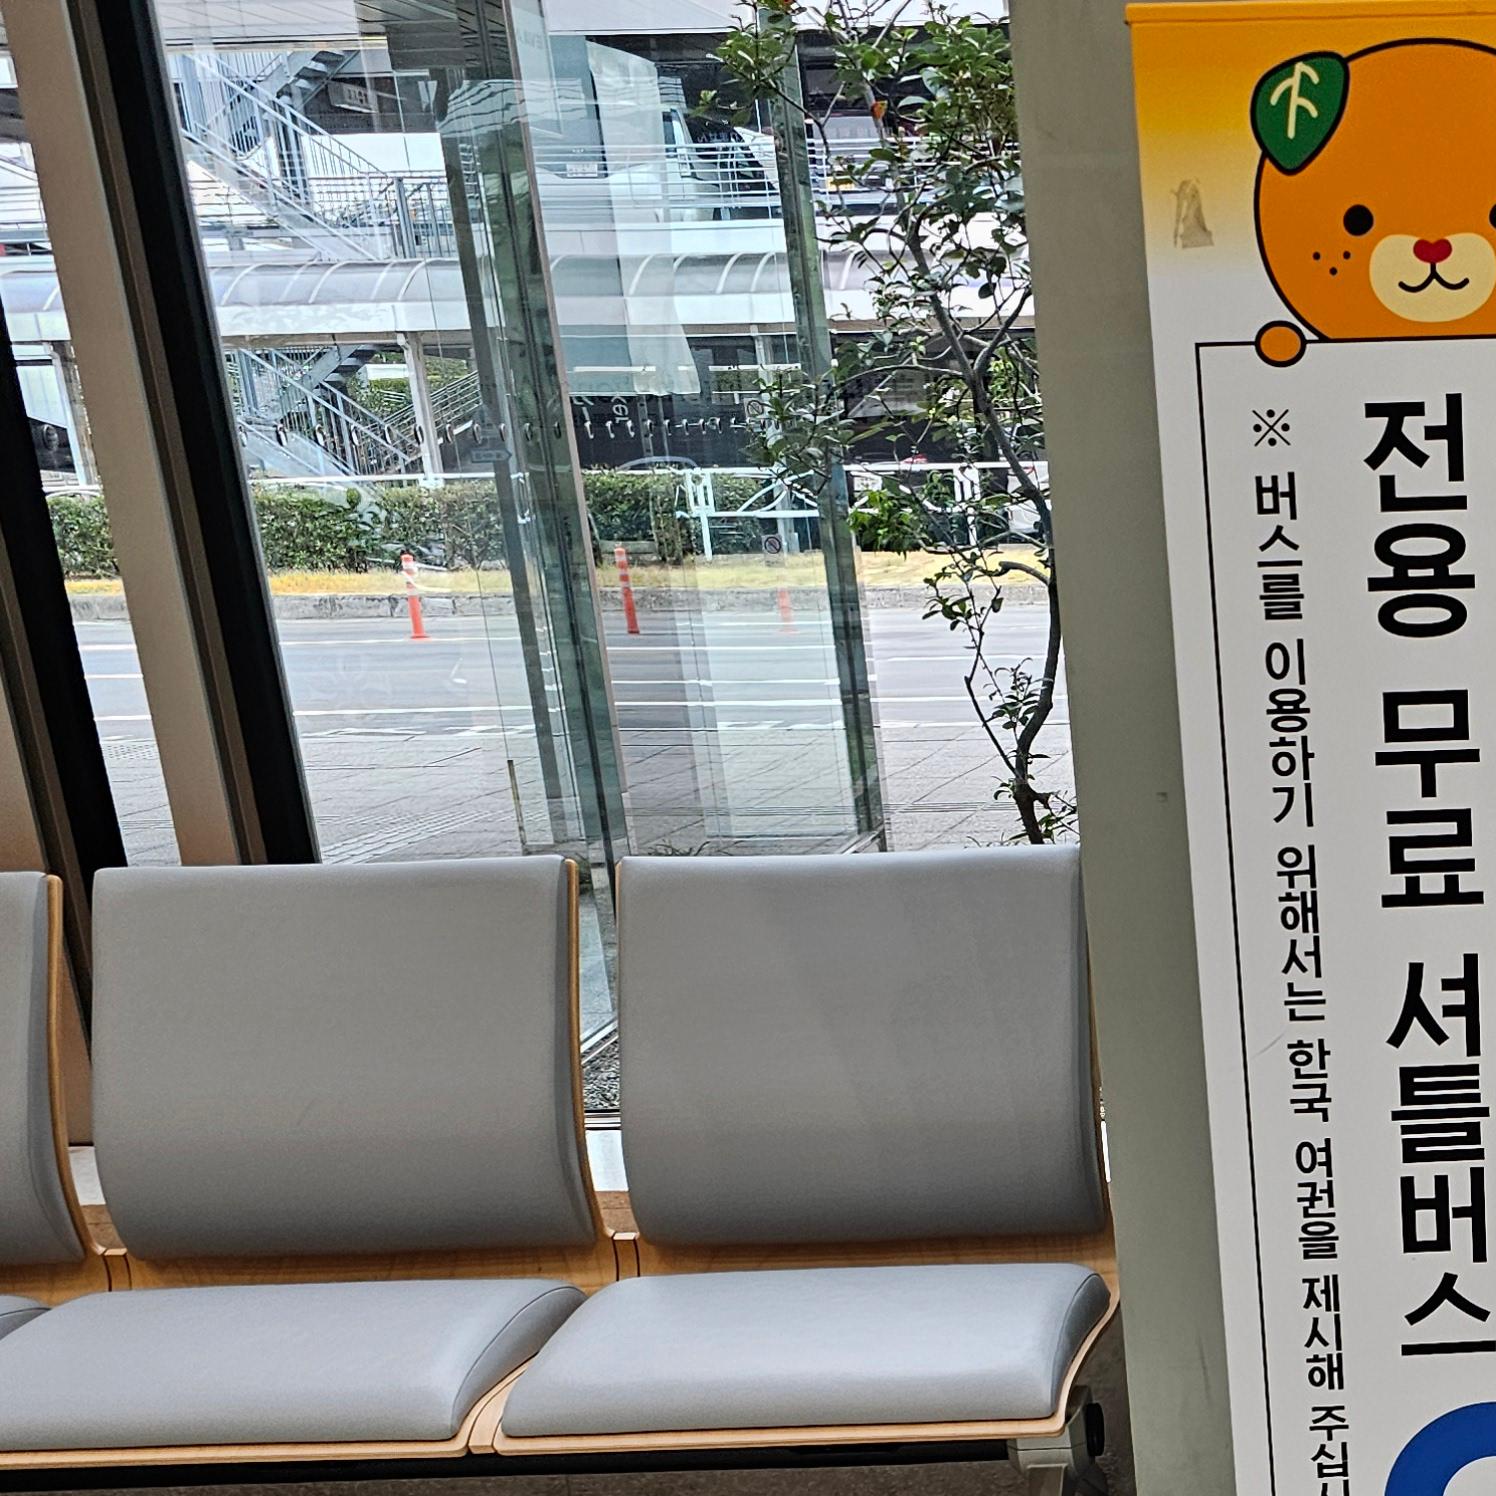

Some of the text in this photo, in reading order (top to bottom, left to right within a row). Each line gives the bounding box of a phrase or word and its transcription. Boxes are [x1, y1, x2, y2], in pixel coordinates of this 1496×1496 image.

[1254, 471, 1305, 620] 버스를
[1362, 392, 1477, 639] 전용
[1264, 637, 1315, 828] 이용하기
[1374, 688, 1485, 909] 무료
[1276, 843, 1327, 1022] 위해서는
[1286, 1037, 1333, 1123] 한국
[1294, 1136, 1340, 1261] 여권을
[1301, 1273, 1346, 1391] 제시해
